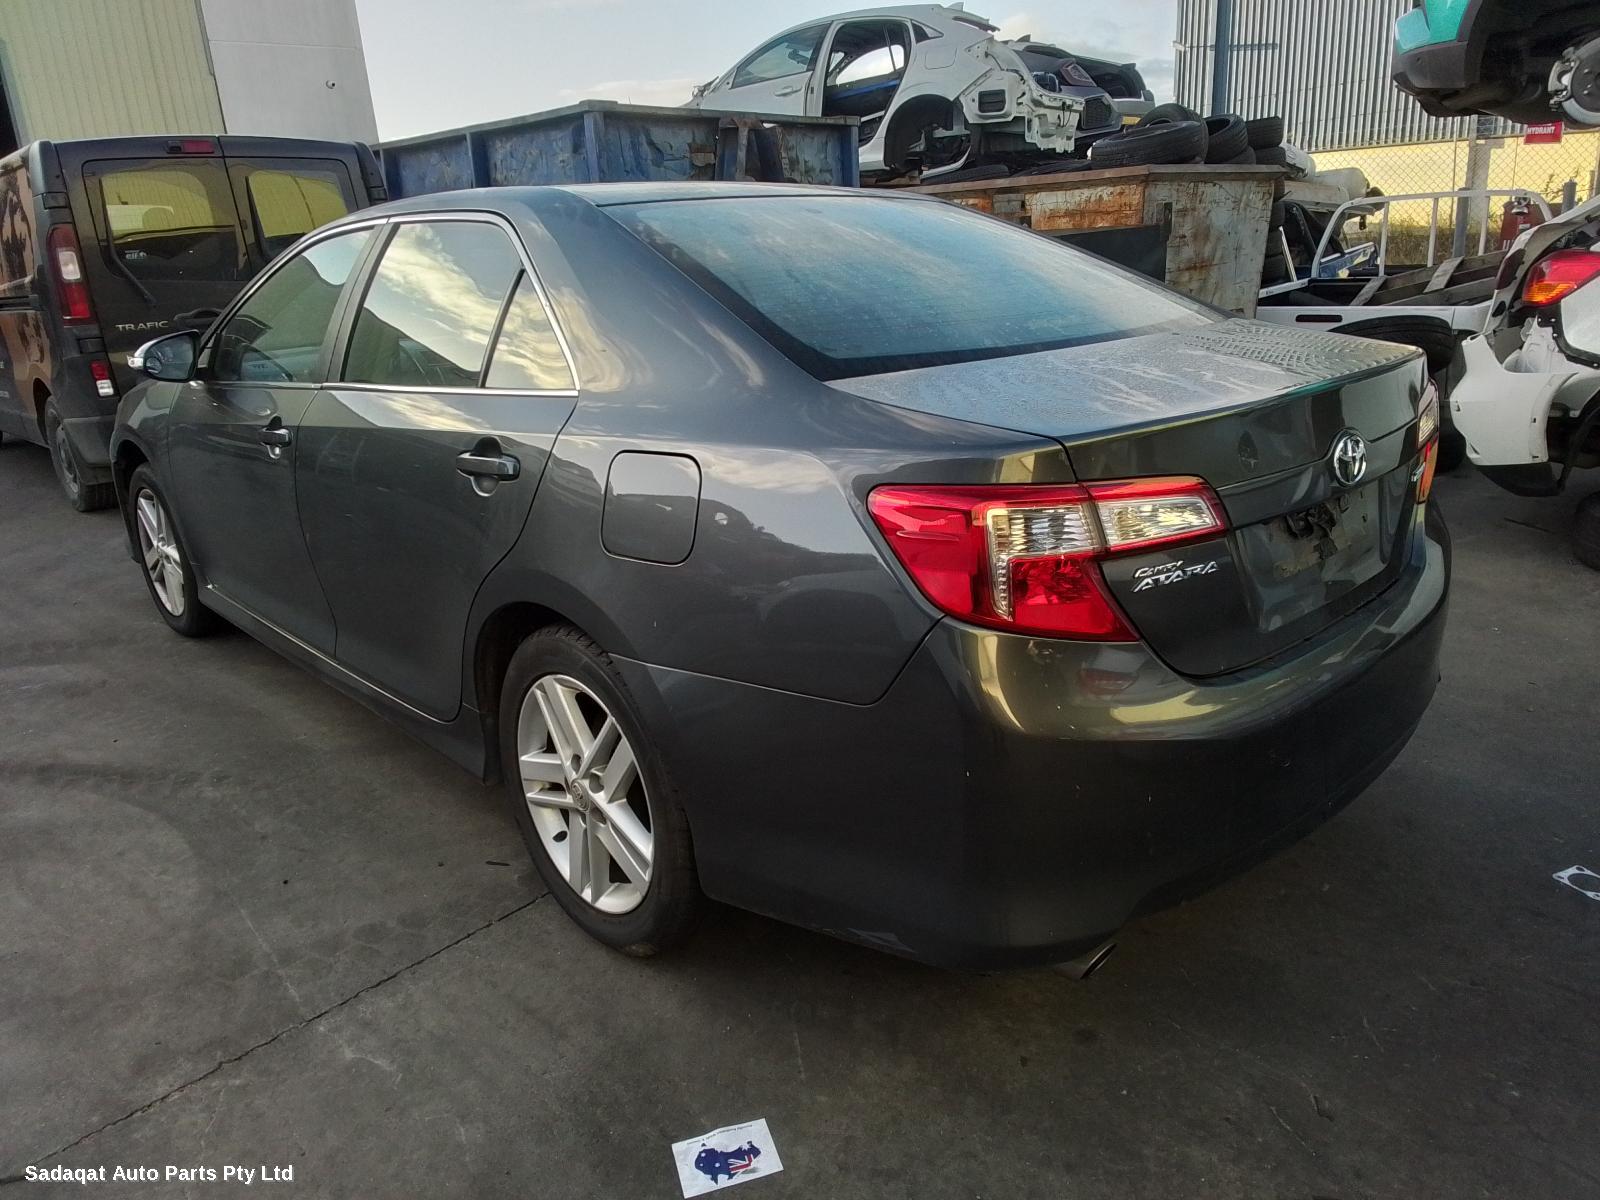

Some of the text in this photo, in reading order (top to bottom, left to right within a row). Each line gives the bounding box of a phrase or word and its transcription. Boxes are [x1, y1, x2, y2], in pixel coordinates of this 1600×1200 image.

[1527, 126, 1556, 135] HYDRANT
[115, 320, 169, 332] TRAFIC
[1131, 561, 1218, 593] ATARA
